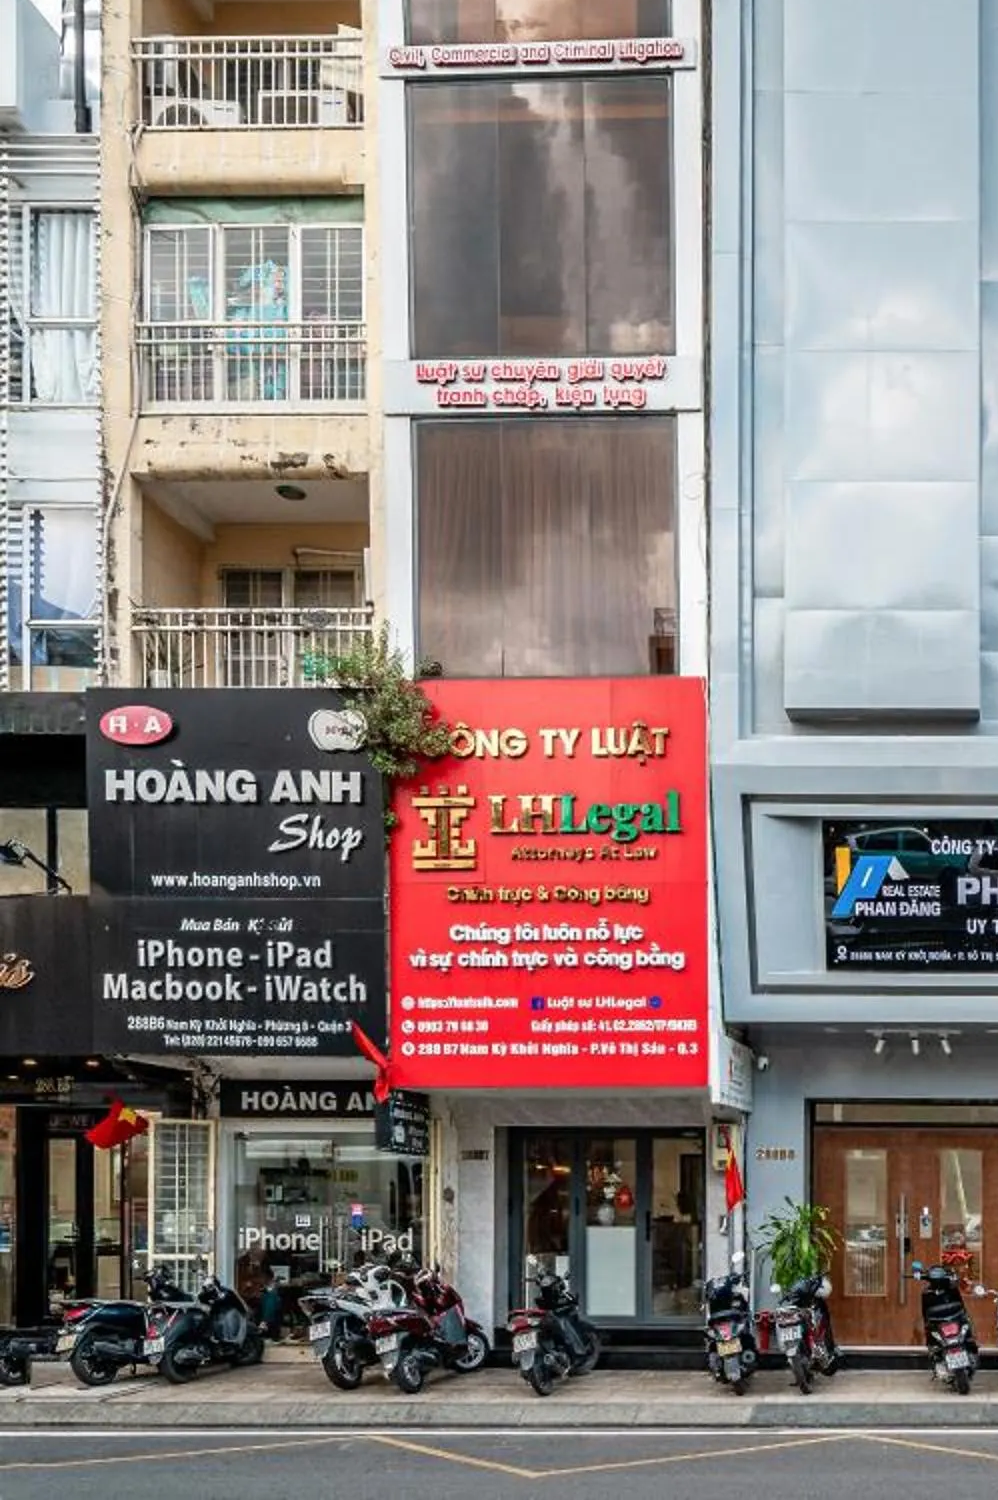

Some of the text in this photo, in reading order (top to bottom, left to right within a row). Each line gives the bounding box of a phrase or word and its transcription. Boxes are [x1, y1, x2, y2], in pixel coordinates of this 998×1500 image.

[431, 45, 517, 66] Commercial
[521, 43, 550, 65] and
[554, 42, 614, 63] Criminal
[617, 40, 684, 65] Litigation
[462, 364, 484, 382] sư
[491, 362, 560, 387] chuyên
[611, 355, 666, 382] quyết
[436, 387, 486, 407] tranh
[555, 385, 595, 409] kiện
[603, 385, 646, 409] tụng
[108, 715, 162, 733] H A
[449, 720, 670, 765] ÔNG TY LUẬT
[105, 759, 361, 803] HOÀNG ANH
[488, 790, 684, 843] LHLegal
[267, 813, 363, 864] Shop
[931, 836, 972, 855] CÔNG
[975, 839, 996, 855] TY
[512, 844, 657, 863] Attorneys At Law
[151, 872, 321, 891] www.hoanganhshop.vn
[537, 884, 549, 901] &
[882, 885, 941, 897] REAL ESTATE
[855, 899, 941, 916] PHAN ĐĂNG
[180, 917, 211, 931] Mua
[213, 917, 240, 931] Bán
[450, 917, 644, 946] Chúng tôi luôn nỗ lực
[966, 919, 987, 935] UY
[137, 939, 243, 968] iPhone
[266, 940, 332, 968] iPad
[409, 943, 686, 972] vì sự chính trực và công bằng
[103, 973, 243, 1001] Macbook
[264, 974, 367, 1002] iWatch
[166, 1020, 188, 1030] Nam
[241, 1085, 337, 1111] HOÀNG
[238, 1227, 413, 1252] iPhone iPad
